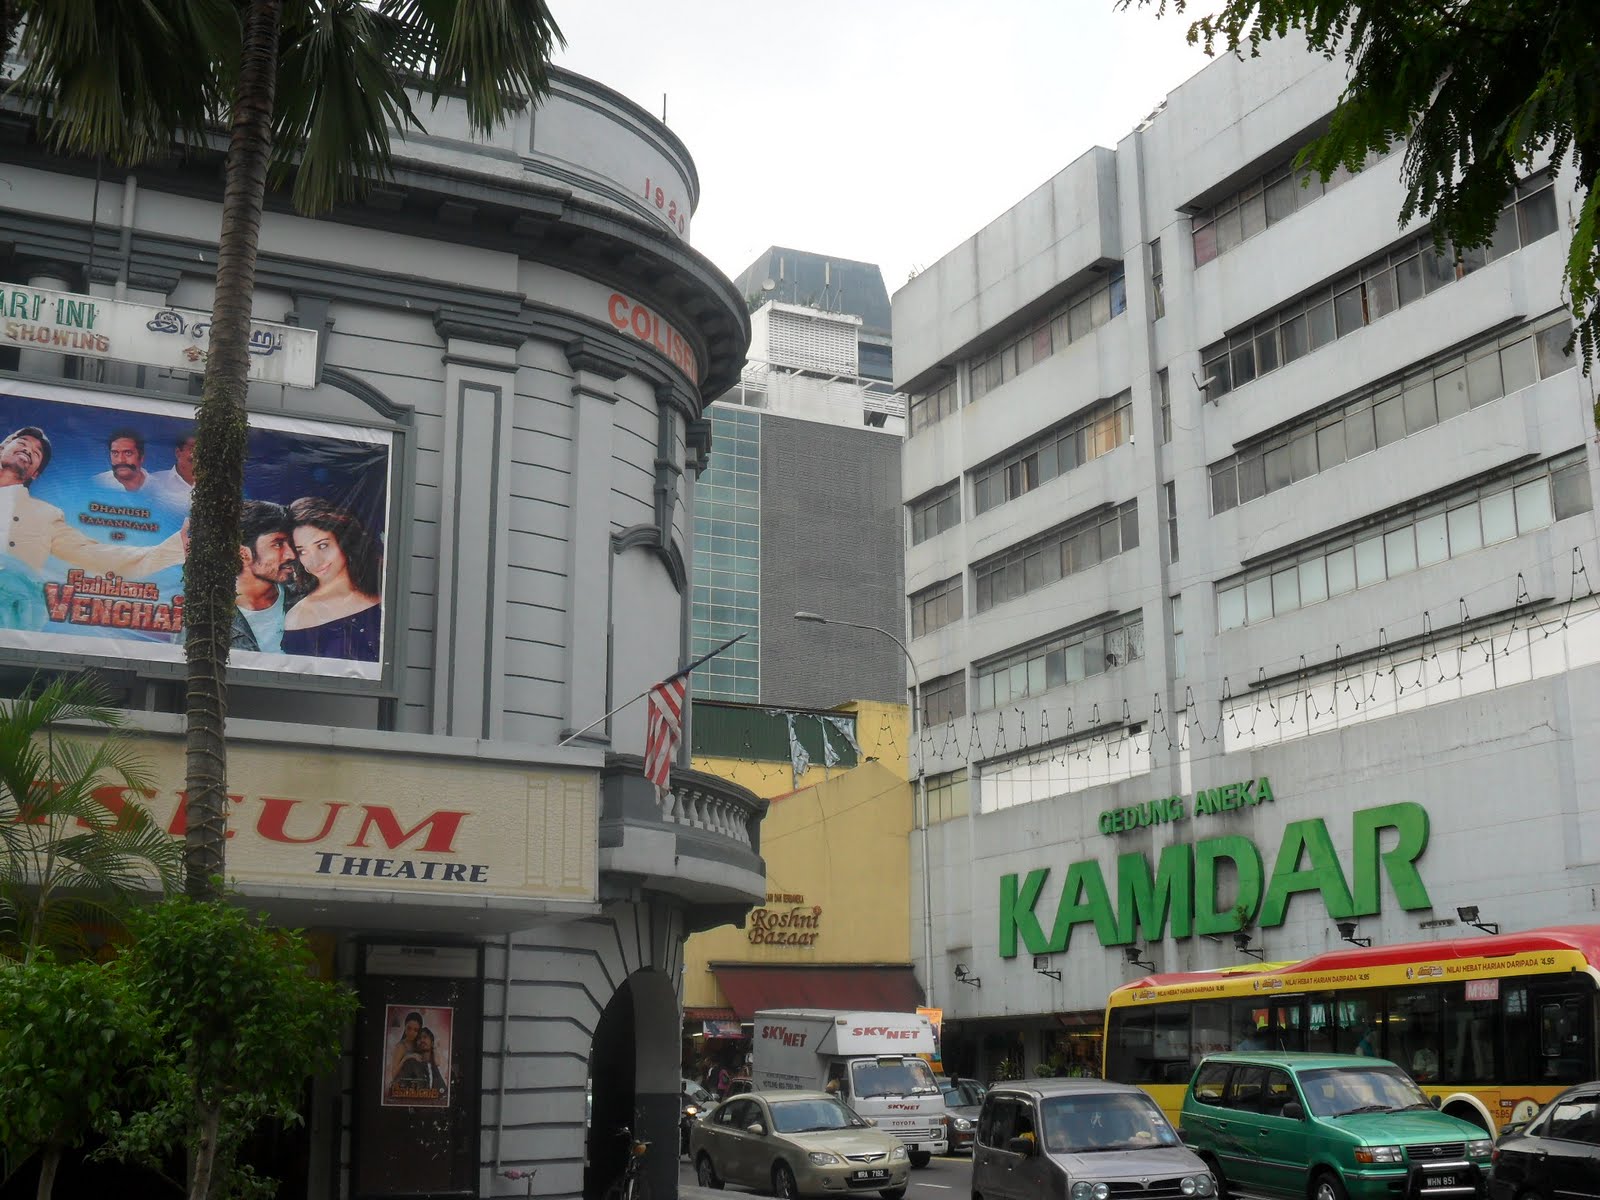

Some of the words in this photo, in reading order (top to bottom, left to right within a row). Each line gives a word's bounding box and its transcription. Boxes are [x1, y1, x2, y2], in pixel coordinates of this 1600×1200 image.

[645, 177, 685, 234] 1920
[56, 298, 96, 329] INI
[5, 321, 110, 352] SHOWING
[90, 502, 150, 518] DHANUSH
[1099, 795, 1184, 835] GEDUNG
[1193, 776, 1274, 817] ANEKA
[314, 851, 489, 884] THEATRE
[999, 801, 1433, 958] KAMDAR
[751, 906, 821, 930] Roshni
[748, 927, 819, 945] Bazaar
[1462, 963, 1482, 972] HEBAT
[1482, 962, 1506, 971] HARIAN
[1506, 959, 1538, 968] DARIPADA
[762, 1025, 807, 1048] SKYNET
[851, 1026, 920, 1040] SKYNET
[1427, 1177, 1442, 1186] WHN
[1443, 1176, 1455, 1185] 851
